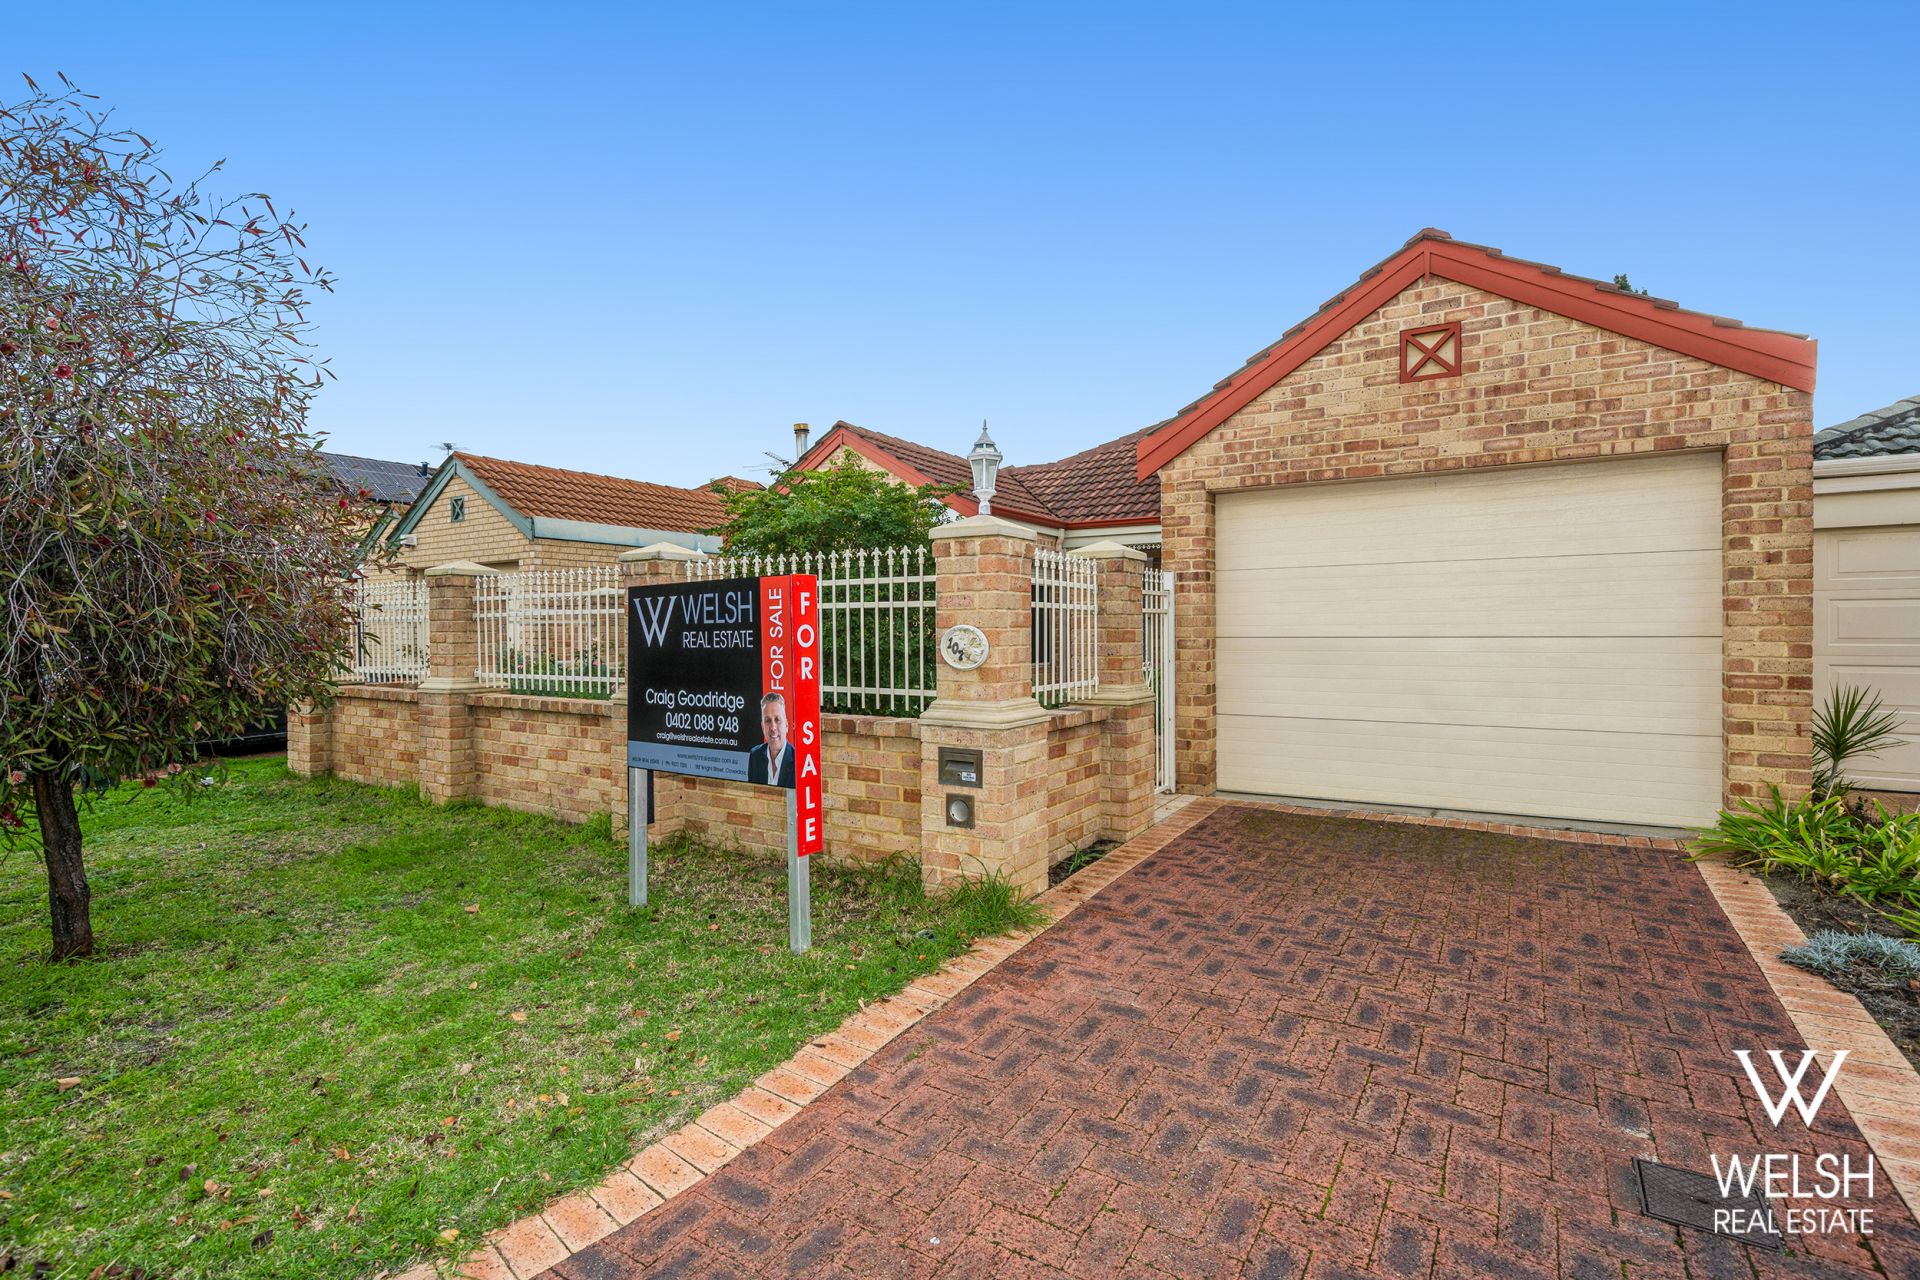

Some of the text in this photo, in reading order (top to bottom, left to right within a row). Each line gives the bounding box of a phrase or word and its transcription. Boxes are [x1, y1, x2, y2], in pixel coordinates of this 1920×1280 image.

[681, 590, 753, 625] WELSH
[633, 596, 677, 647] W
[682, 630, 754, 648] REAL ESTATE
[769, 588, 785, 690] FOR SALE
[645, 688, 745, 712] Craig Goodridge
[665, 711, 739, 733] 0402 088 948
[656, 731, 738, 746] craig@welshrealestate.com.au
